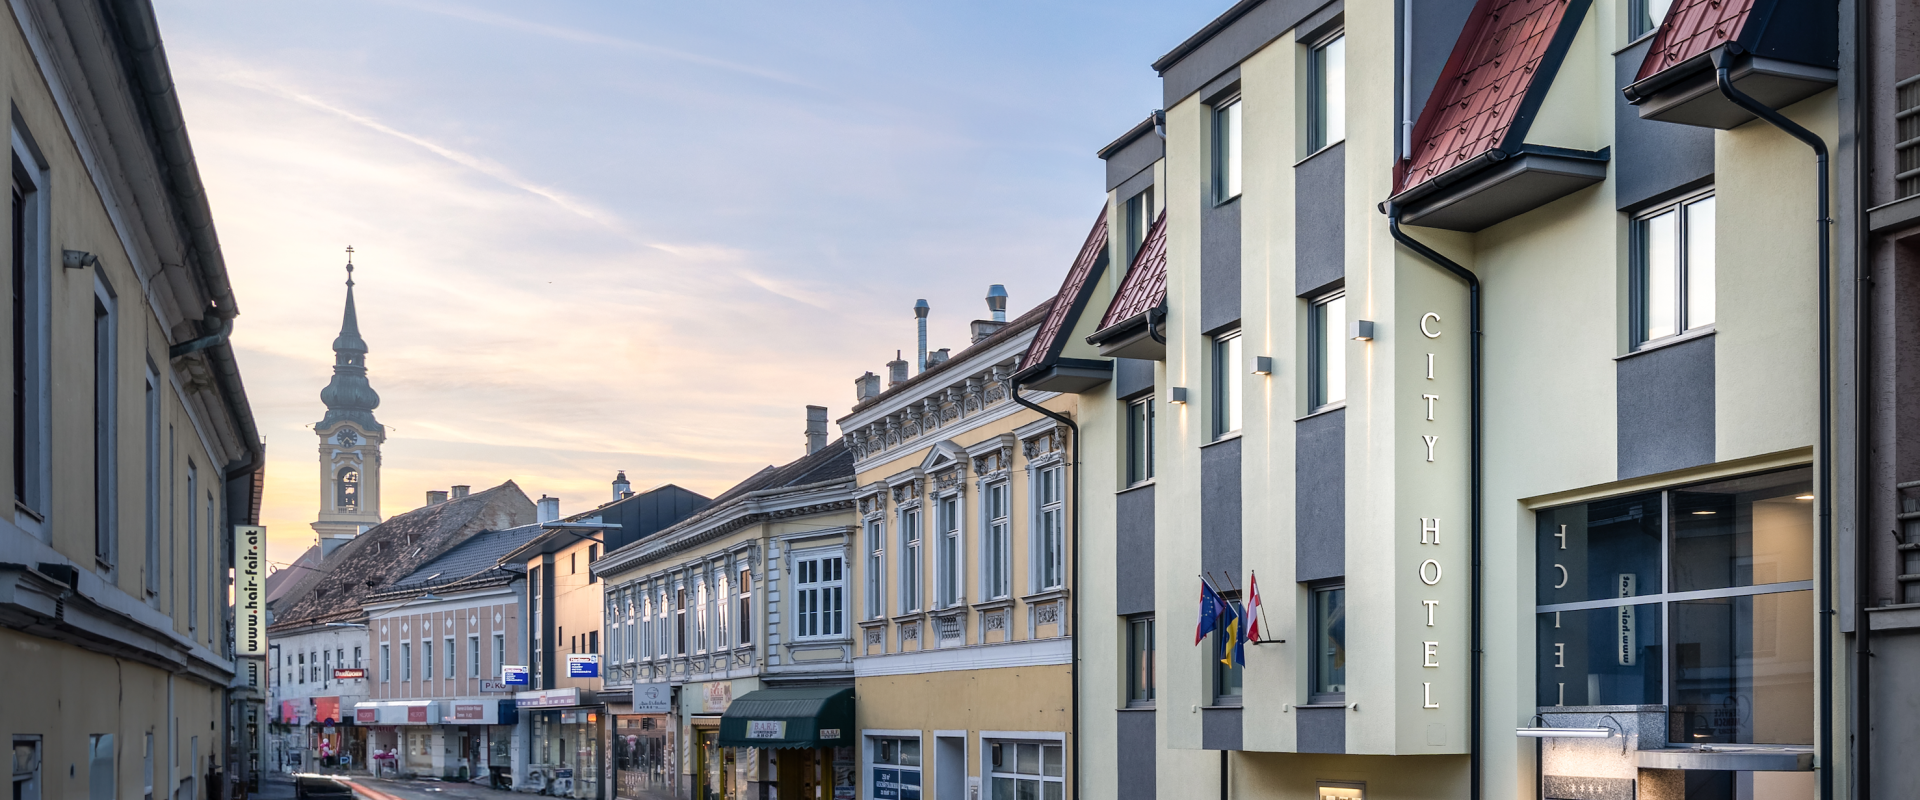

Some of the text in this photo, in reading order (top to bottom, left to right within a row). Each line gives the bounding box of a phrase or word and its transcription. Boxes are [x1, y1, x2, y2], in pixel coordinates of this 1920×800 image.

[244, 530, 258, 652] www.hair-fair.at
[1419, 311, 1443, 709] CITY HOTEL
